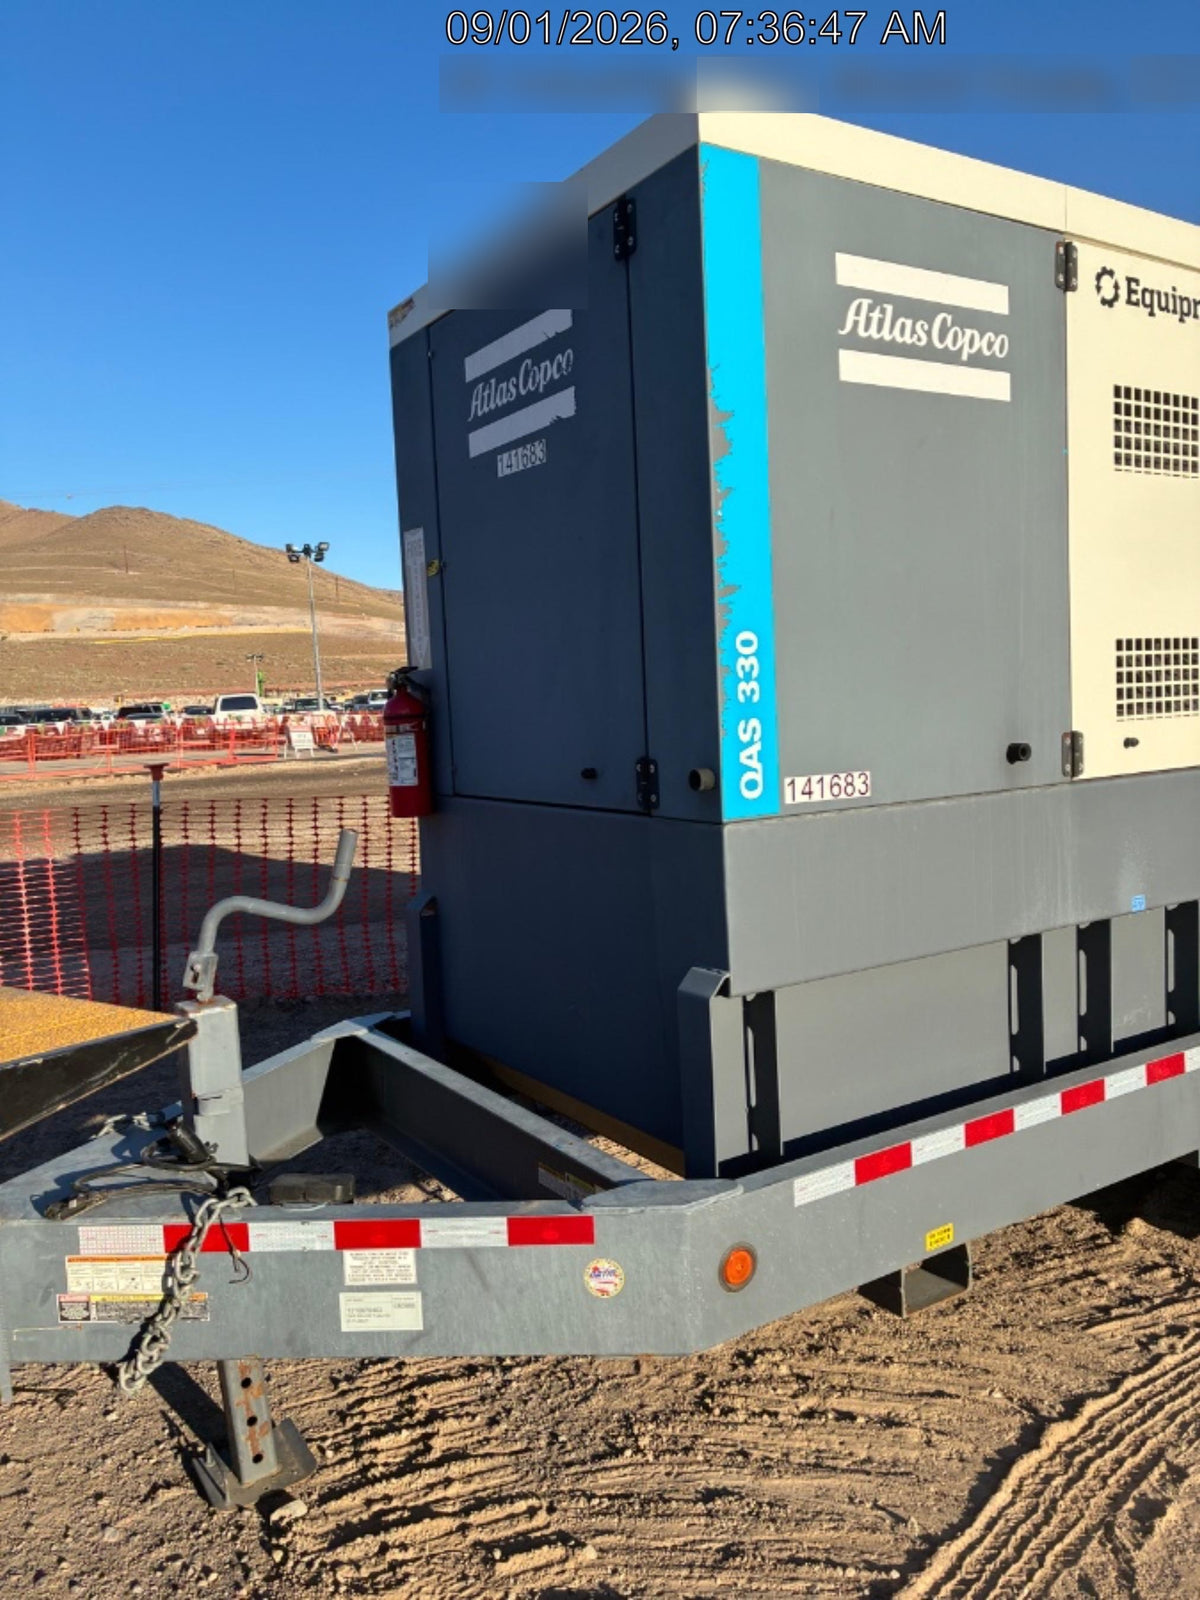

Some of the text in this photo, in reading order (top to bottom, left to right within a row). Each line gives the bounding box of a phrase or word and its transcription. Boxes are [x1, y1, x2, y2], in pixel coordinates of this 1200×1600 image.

[498, 439, 546, 476] 141683
[735, 630, 763, 799] QAS 330
[786, 771, 869, 802] 141683
